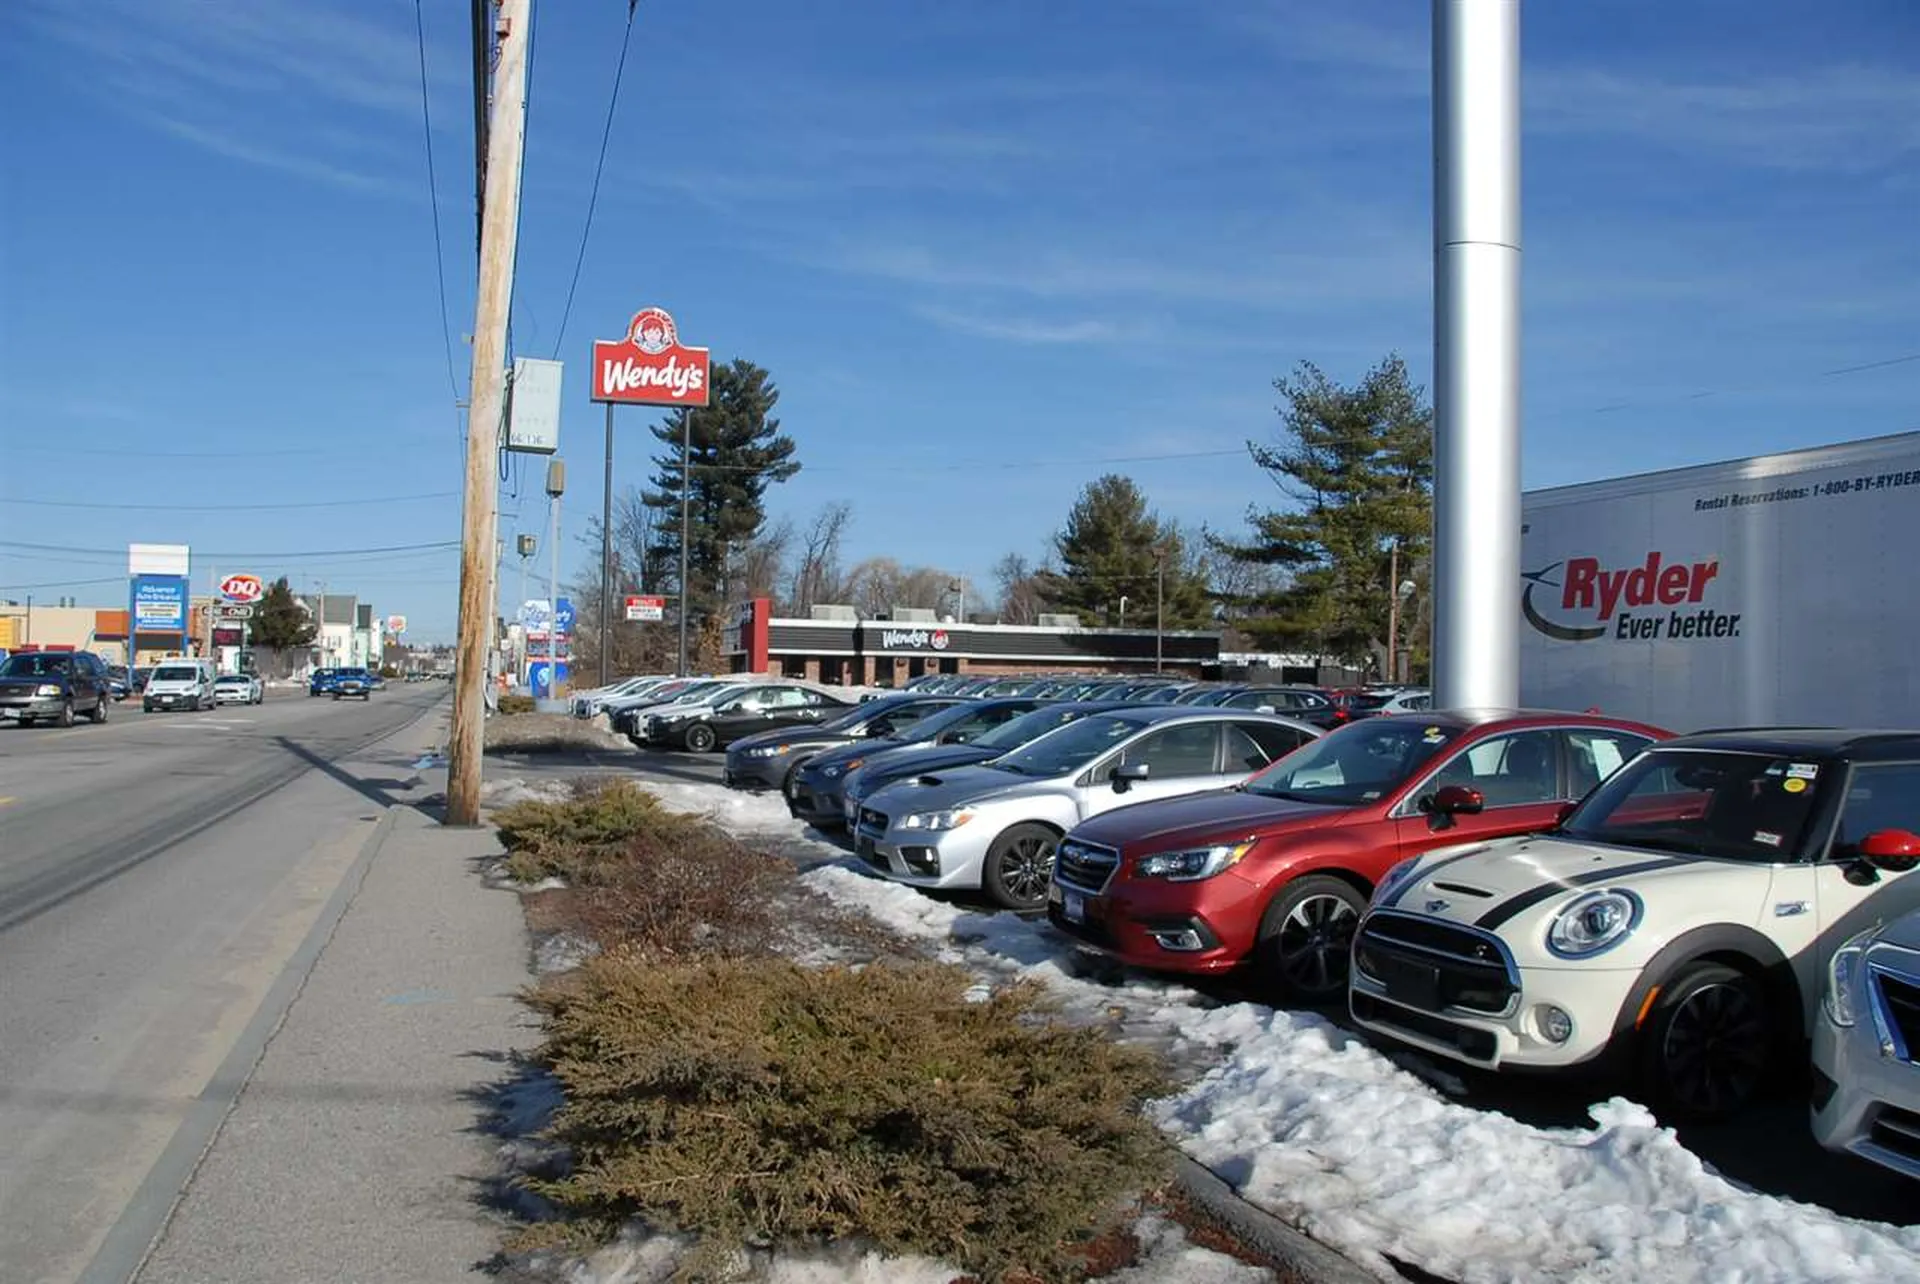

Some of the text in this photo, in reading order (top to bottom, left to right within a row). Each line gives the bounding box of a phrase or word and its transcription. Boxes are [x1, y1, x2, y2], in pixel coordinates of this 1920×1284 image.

[603, 355, 704, 398] Wendy's
[1695, 495, 1729, 511] Rental
[1731, 487, 1810, 507] Reservations:
[228, 580, 257, 596] DQ
[1561, 551, 1720, 621] Ryder
[1616, 610, 1741, 639] Ever better.
[883, 628, 929, 649] Wendy's
